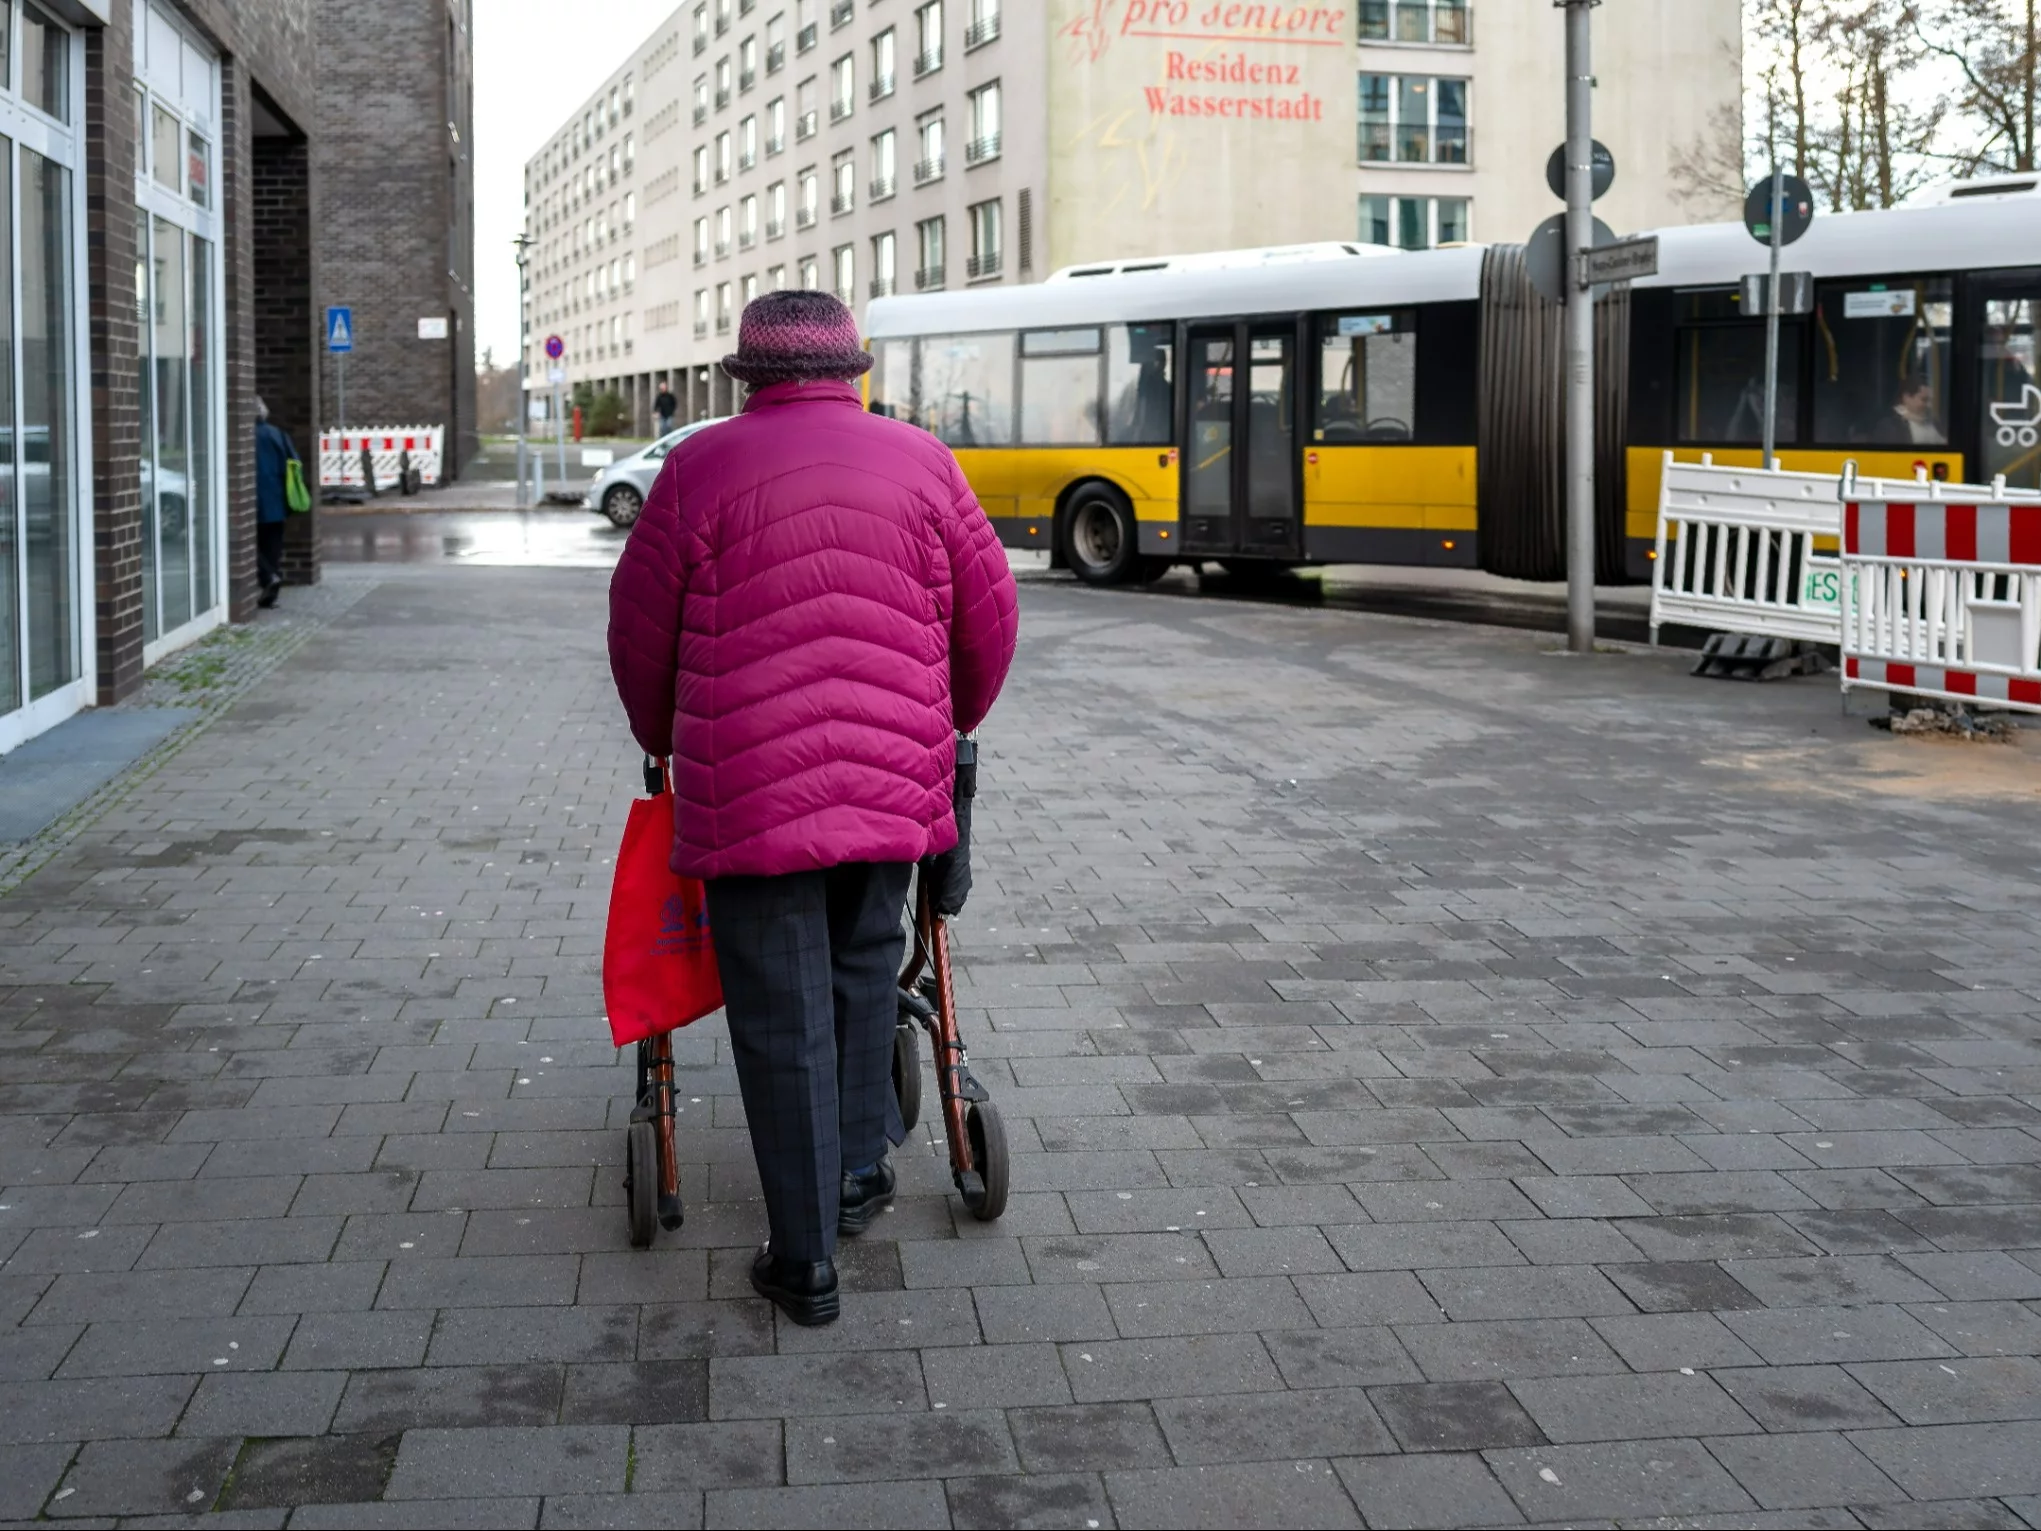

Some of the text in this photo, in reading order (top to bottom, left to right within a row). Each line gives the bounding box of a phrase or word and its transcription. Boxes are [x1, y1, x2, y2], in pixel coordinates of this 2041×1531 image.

[1120, 0, 1189, 36] pro
[1166, 51, 1300, 85] Residenz
[1144, 86, 1323, 121] Wasserstadt
